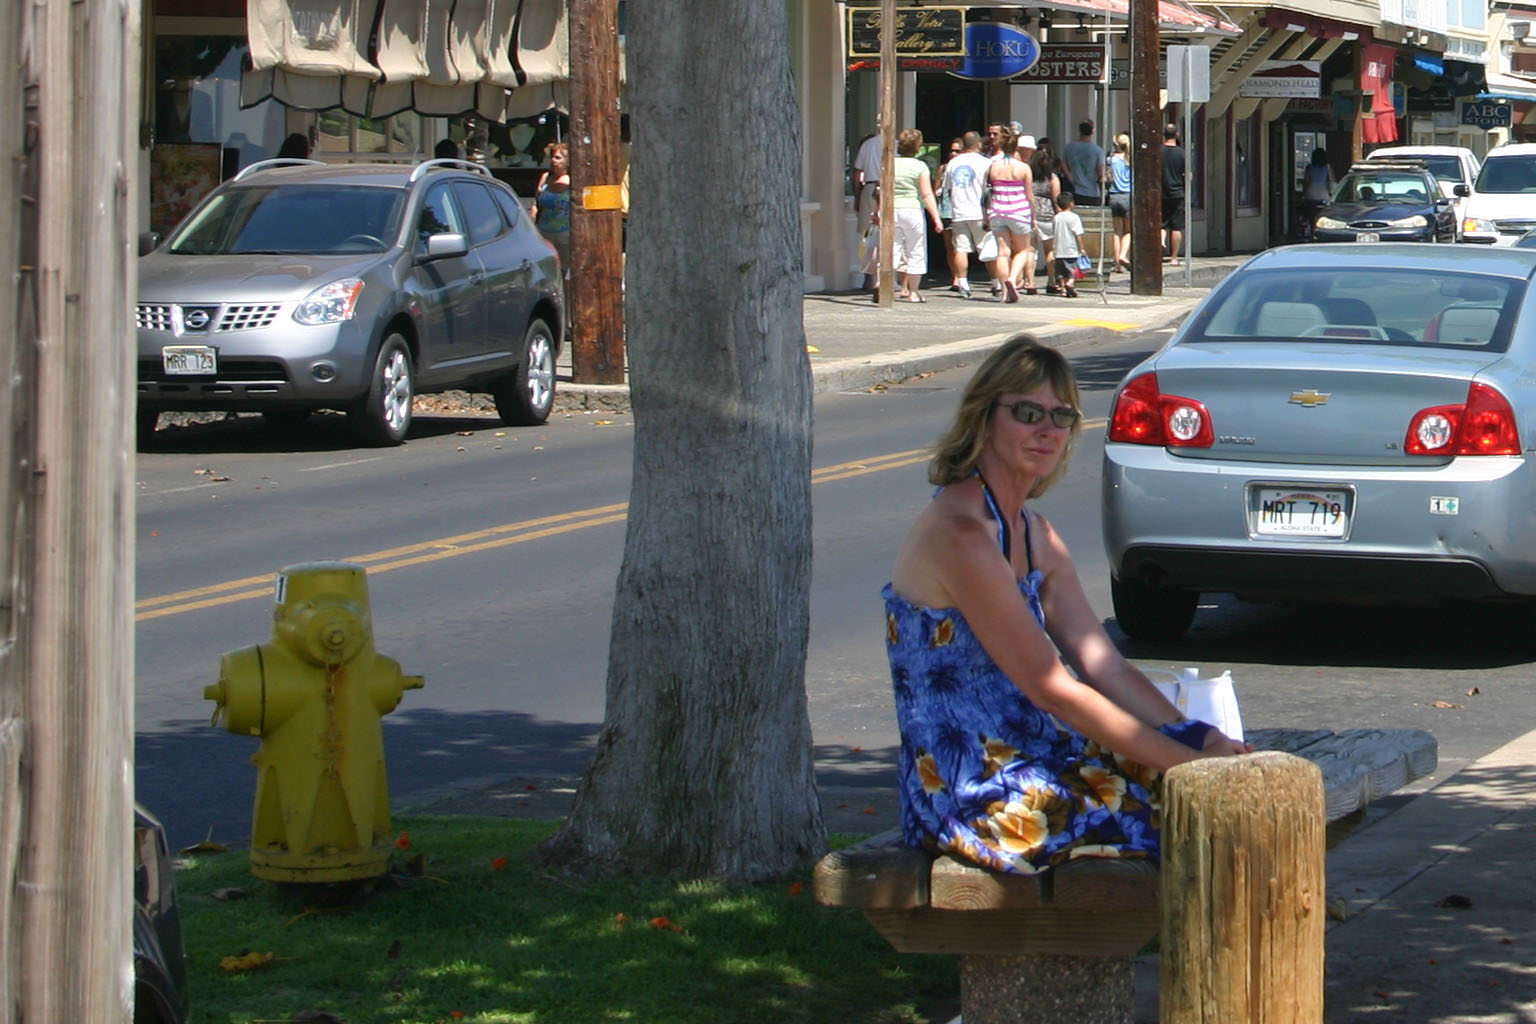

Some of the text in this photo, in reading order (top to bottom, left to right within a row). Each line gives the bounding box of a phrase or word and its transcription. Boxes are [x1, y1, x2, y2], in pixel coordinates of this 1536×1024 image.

[1292, 79, 1318, 89] HEAD
[1466, 105, 1509, 118] ABC
[1465, 116, 1507, 127] STORE
[1262, 499, 1342, 525] MRT 719
